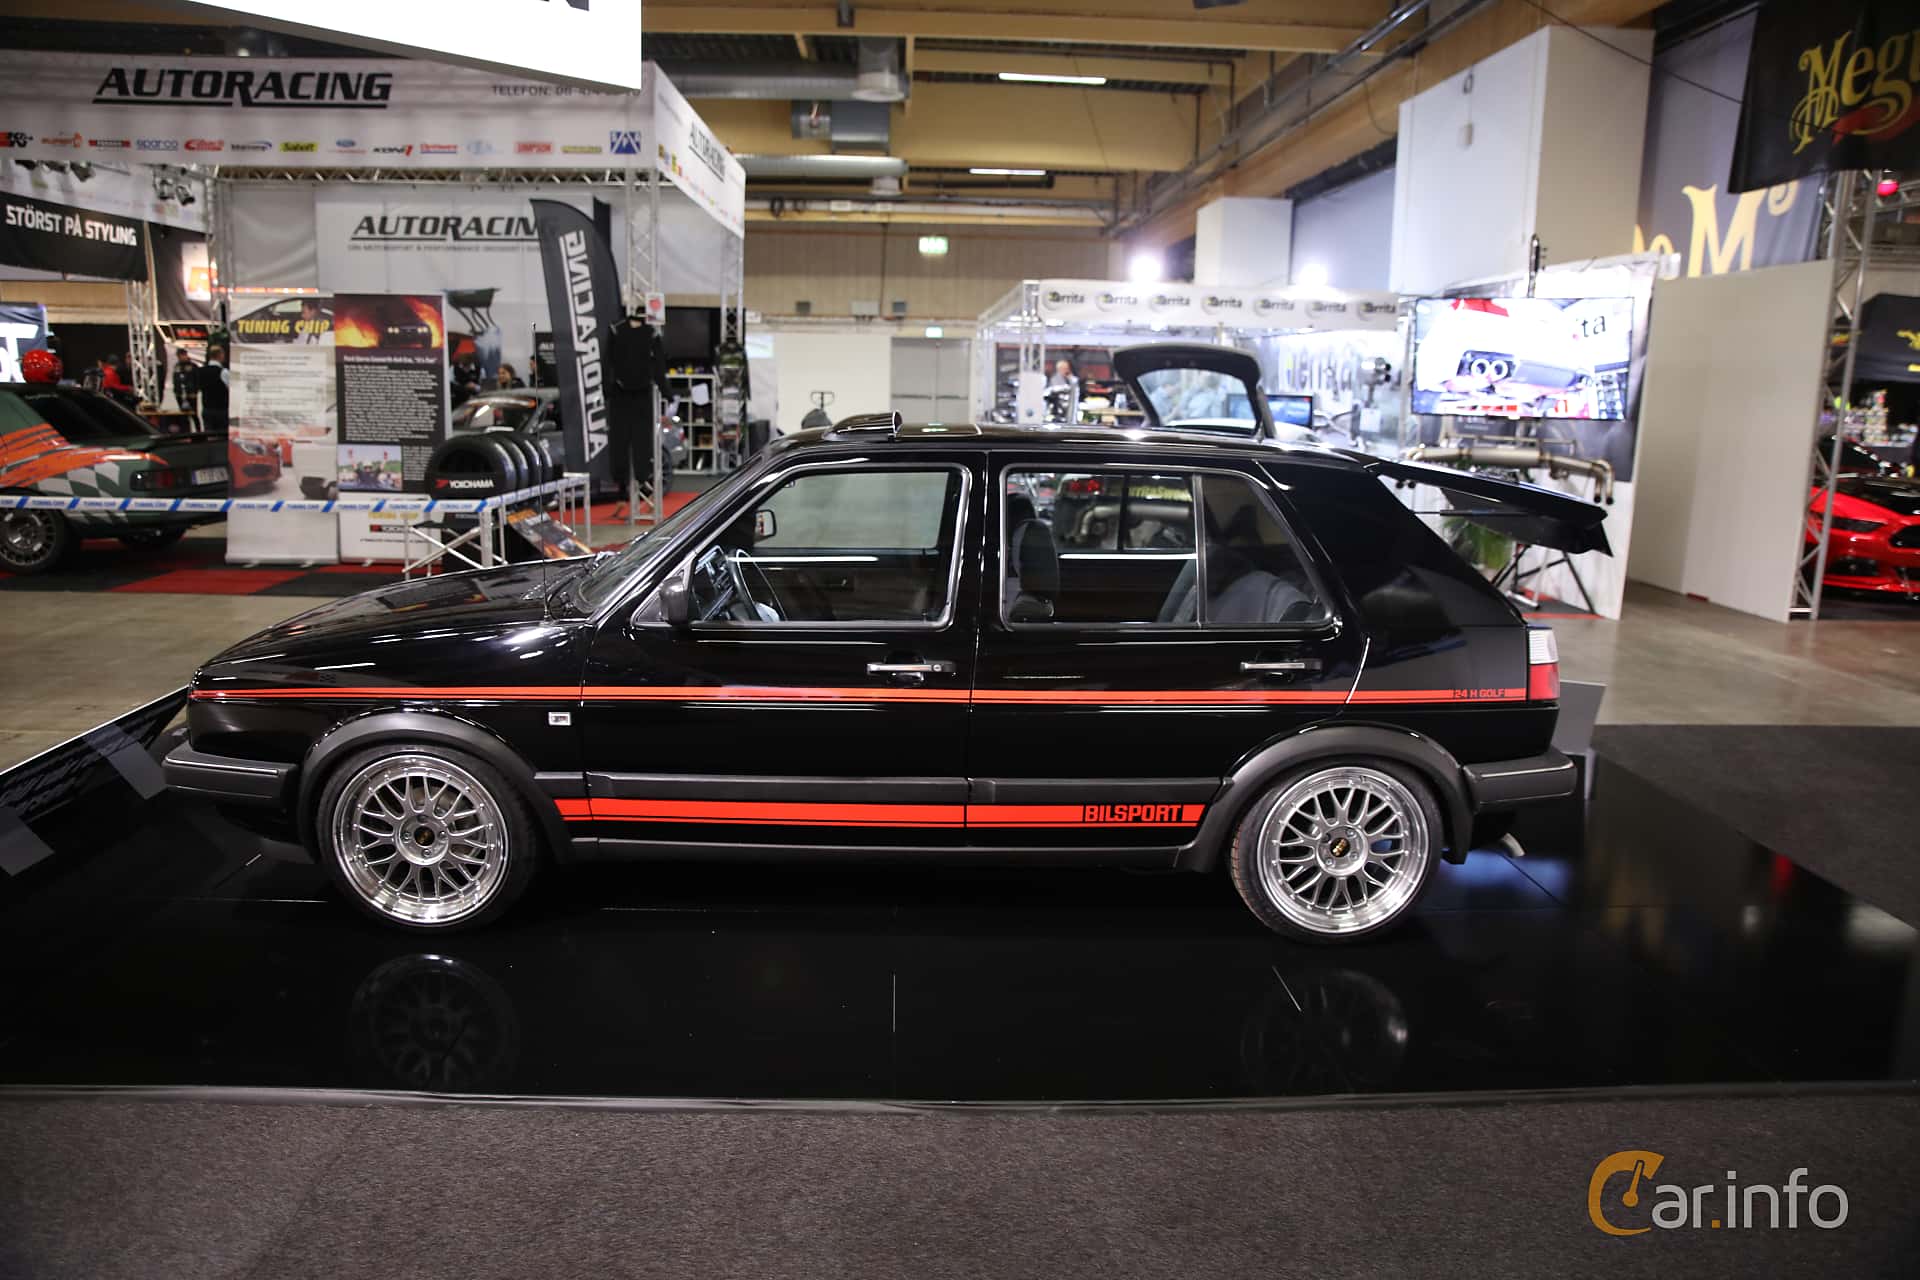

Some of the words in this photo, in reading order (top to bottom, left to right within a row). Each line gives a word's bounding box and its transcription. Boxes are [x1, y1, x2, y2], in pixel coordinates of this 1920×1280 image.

[96, 67, 392, 107] AUTORACING
[1790, 30, 1920, 155] Meg
[5, 203, 62, 233] STÖRST
[64, 213, 83, 238] PÅ
[85, 219, 137, 247] STYLING
[237, 320, 290, 333] TUNING
[294, 320, 330, 334] CHIP
[448, 479, 495, 490] YOKOHAMA
[1084, 804, 1182, 822] BILSPORT
